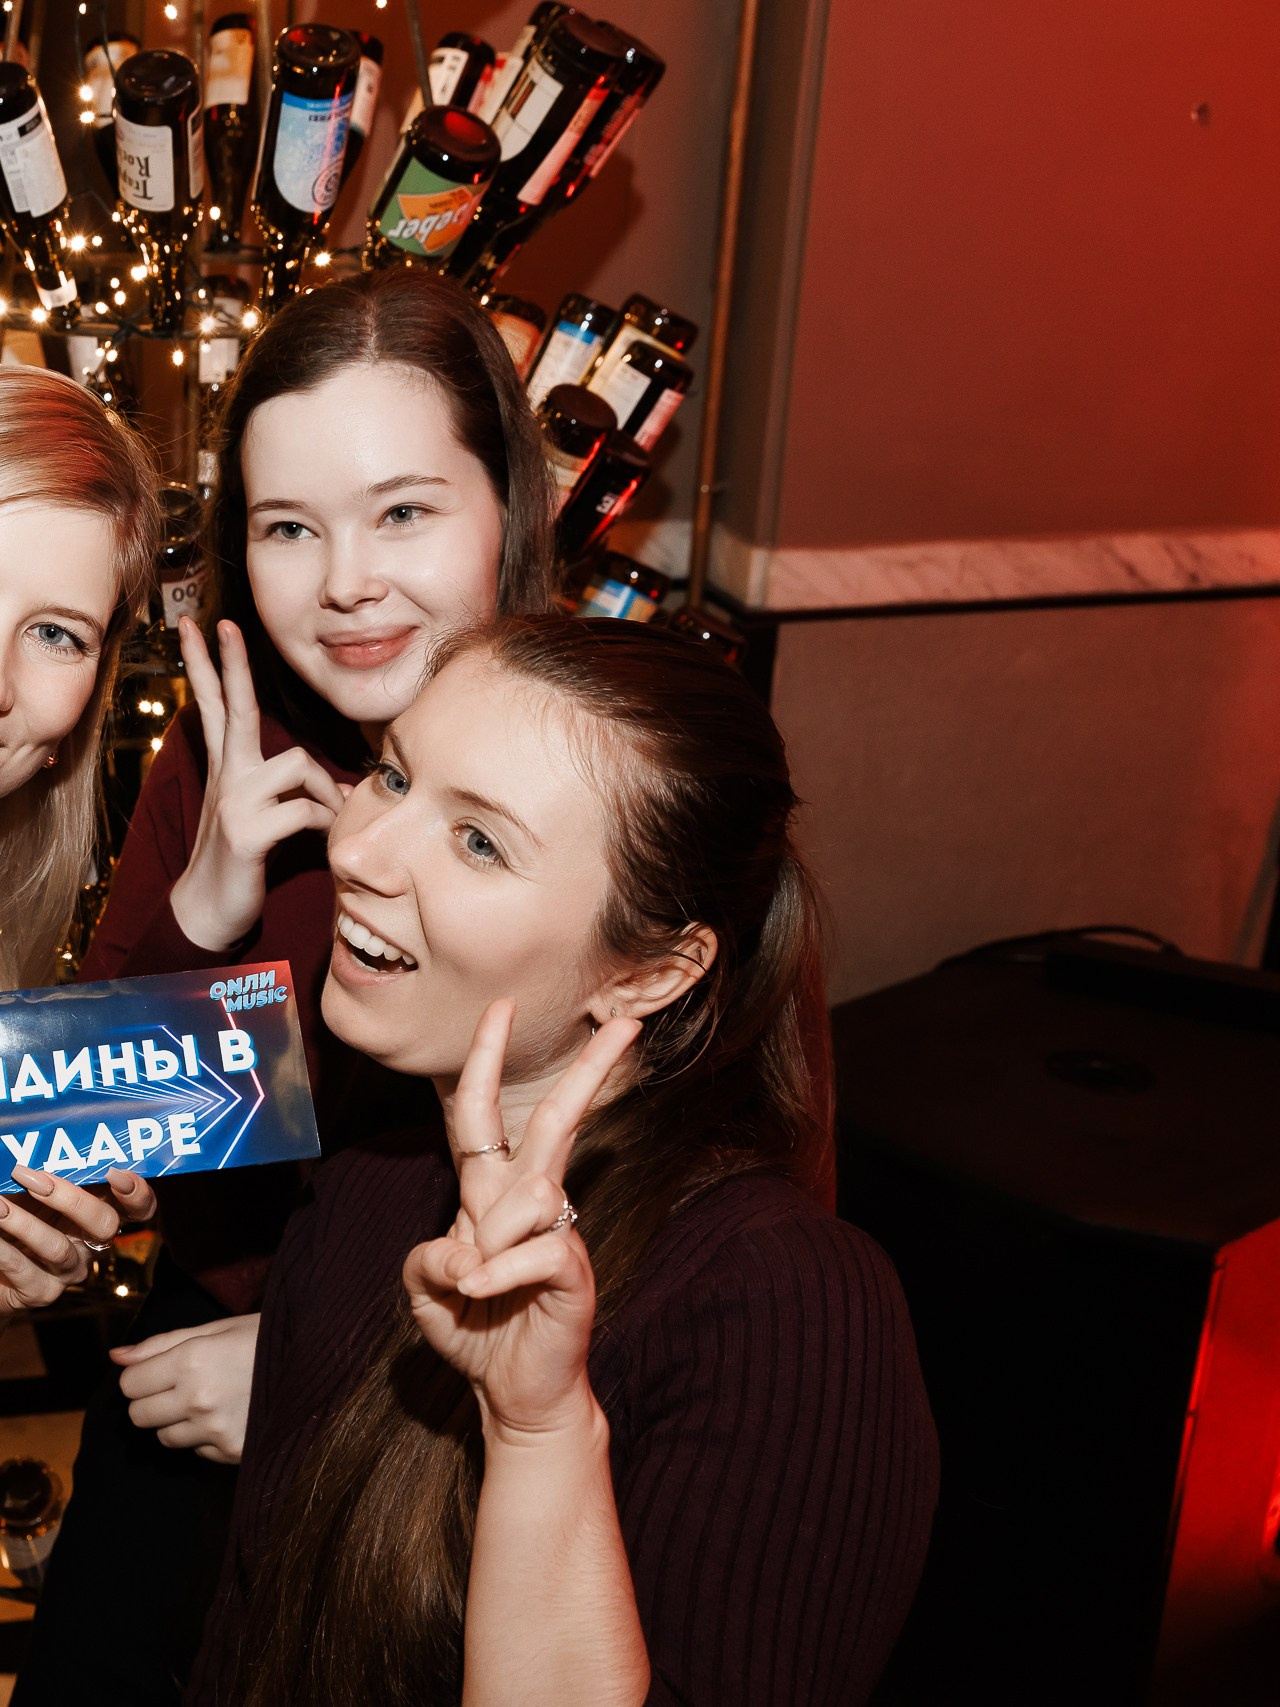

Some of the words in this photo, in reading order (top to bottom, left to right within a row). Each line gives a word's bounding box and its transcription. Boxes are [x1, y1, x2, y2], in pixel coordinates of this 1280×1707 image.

[225, 985, 288, 1015] MUSIC
[218, 1028, 258, 1074] В
[0, 1112, 202, 1175] УДАРЕ
